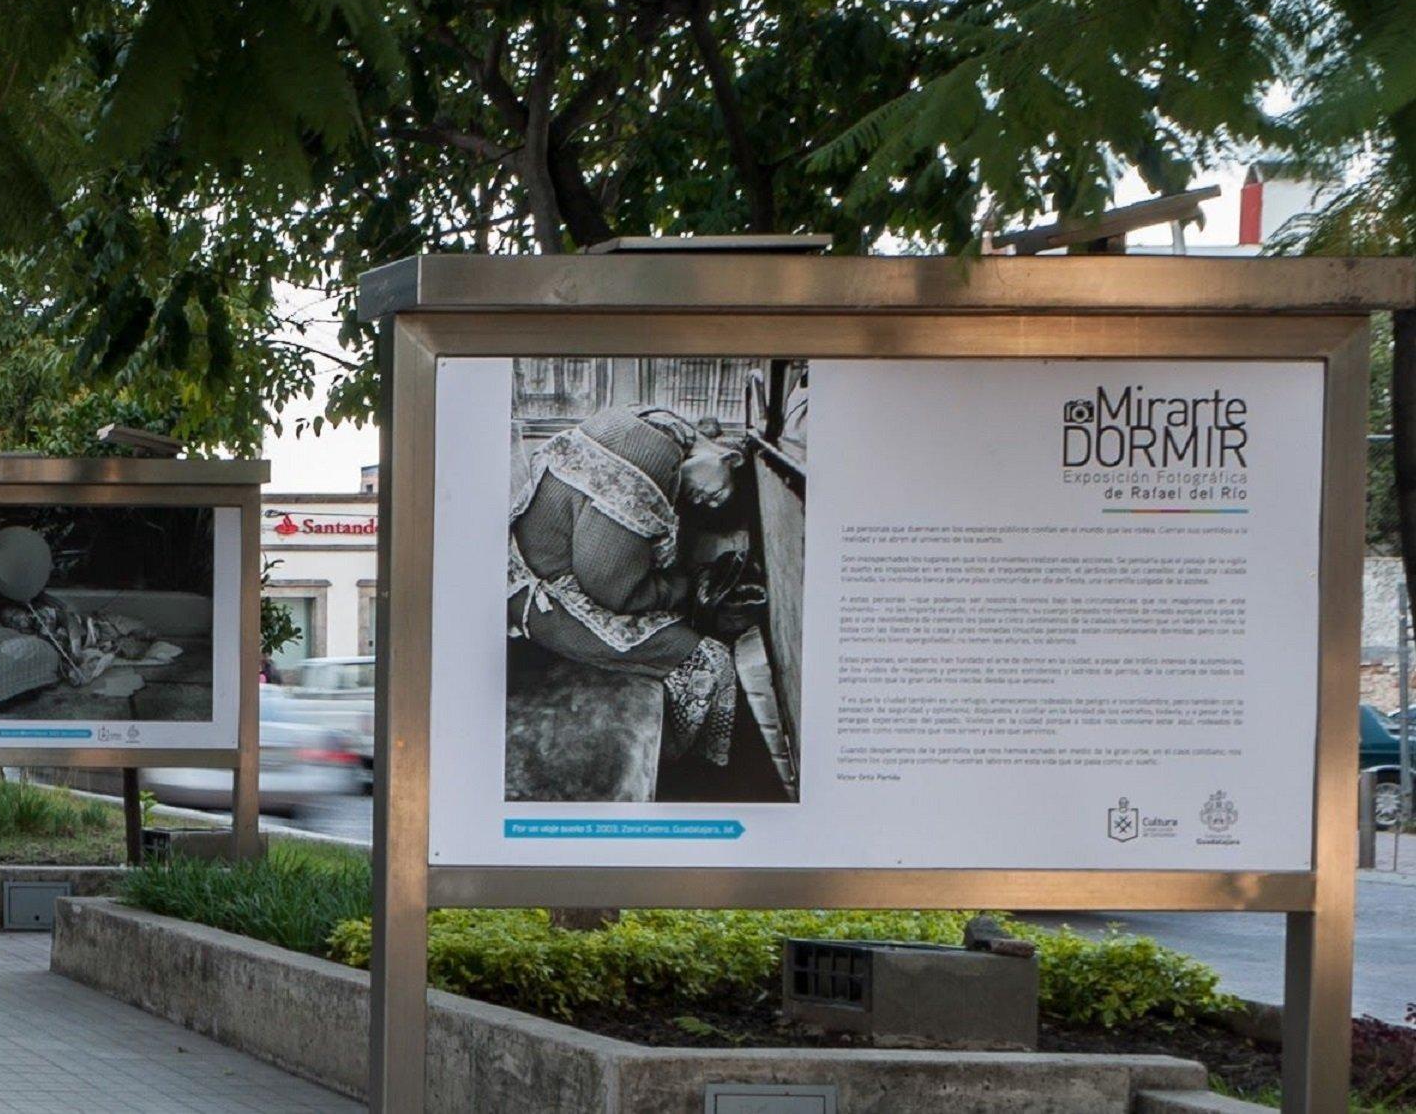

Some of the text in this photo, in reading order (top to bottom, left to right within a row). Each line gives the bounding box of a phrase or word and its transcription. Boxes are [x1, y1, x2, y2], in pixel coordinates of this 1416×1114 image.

[1097, 386, 1248, 427] Mirarte
[1062, 426, 1248, 468] DORMIR
[1063, 470, 1248, 486] Exposición Fotográfica
[1104, 487, 1123, 500] de
[1131, 487, 1182, 500] Rafael
[1189, 487, 1214, 500] del
[302, 518, 381, 535] Santand
[1142, 816, 1178, 827] Cultura
